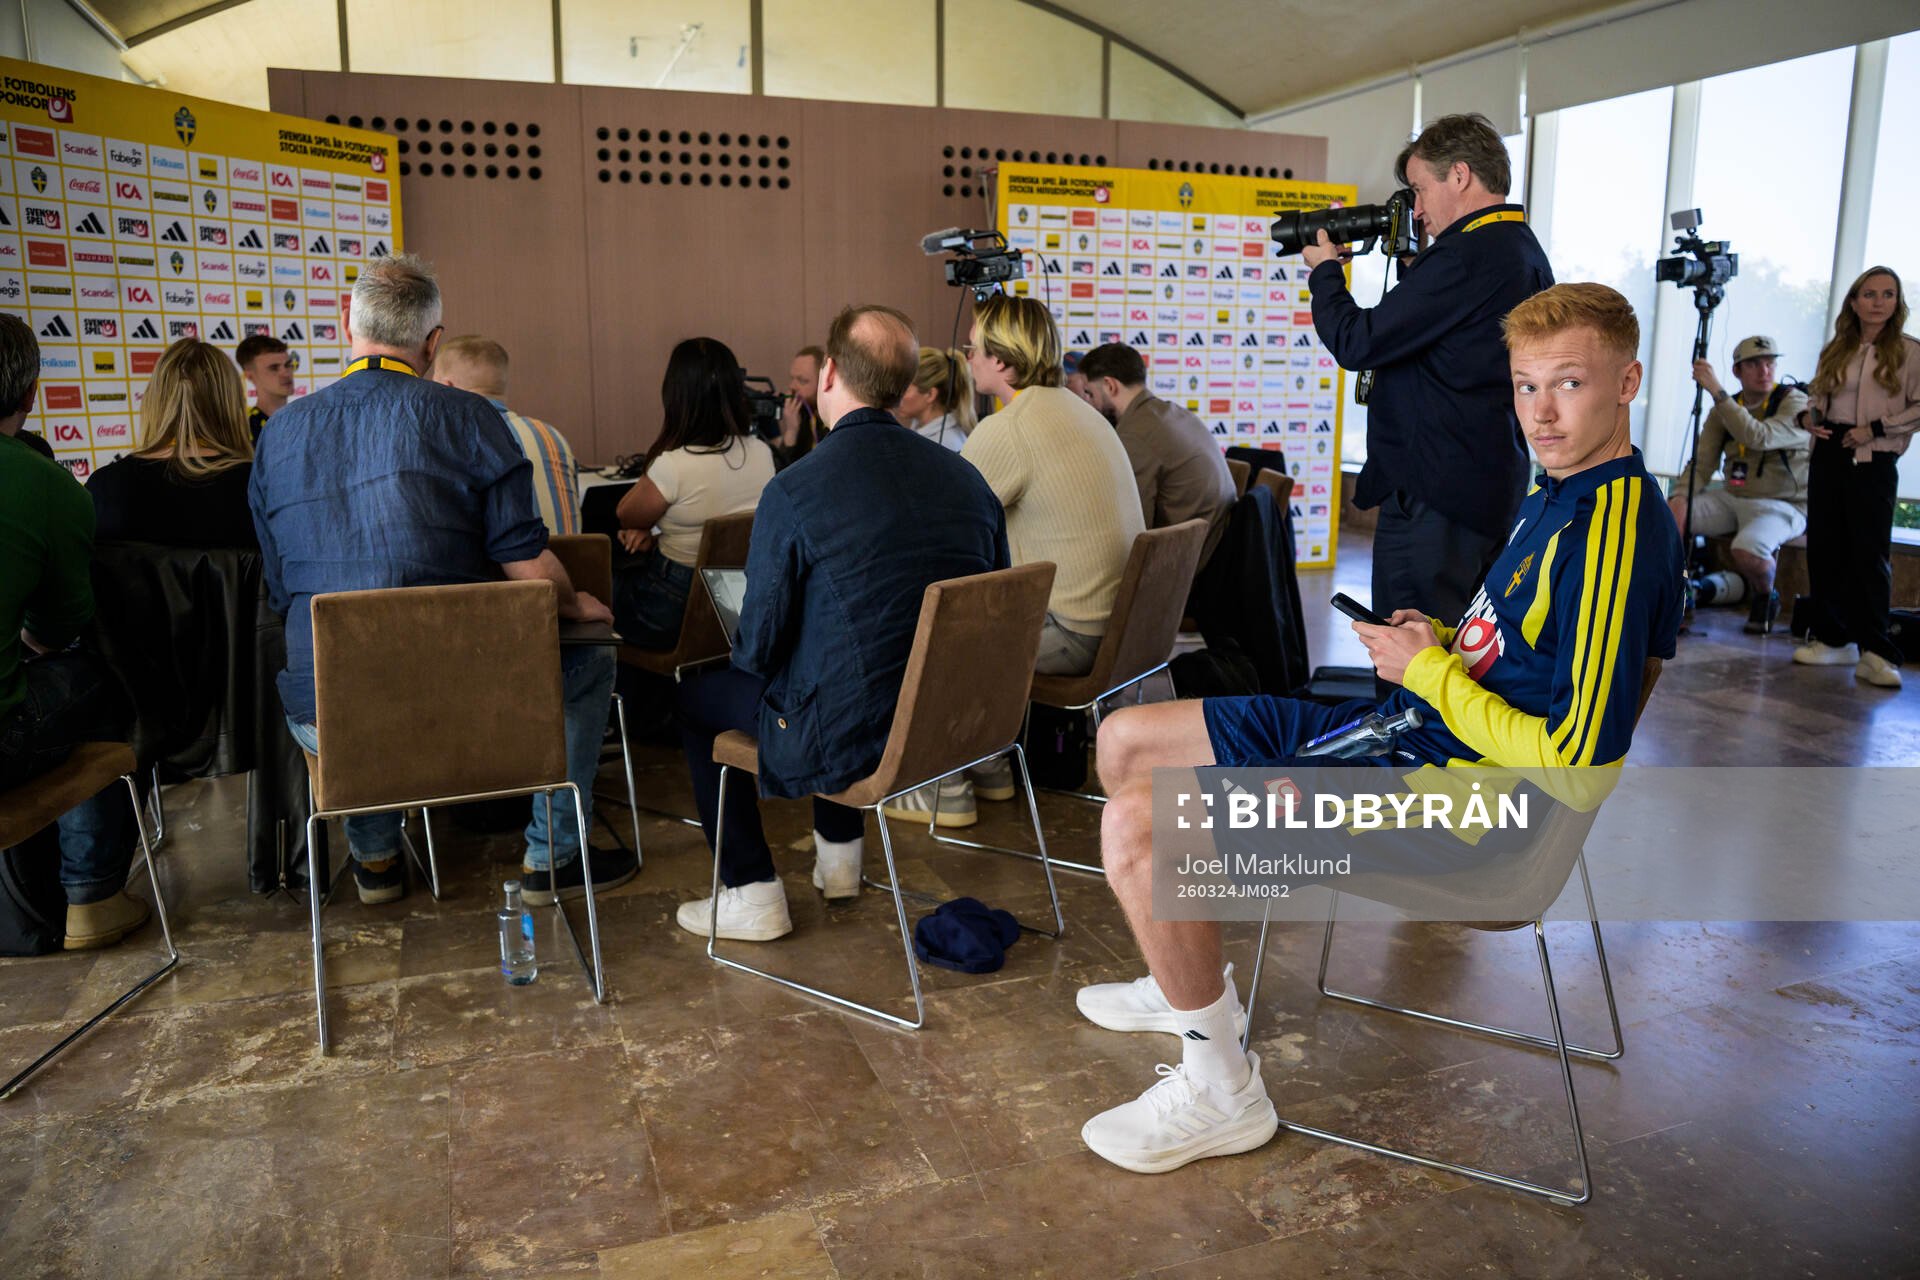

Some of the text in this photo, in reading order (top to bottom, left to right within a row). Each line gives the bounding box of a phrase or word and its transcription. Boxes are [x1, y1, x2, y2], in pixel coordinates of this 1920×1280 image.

[4, 77, 76, 101] FOTBOLLENS
[279, 130, 312, 144] SVENSKA
[314, 135, 331, 147] SPEL
[64, 143, 98, 157] Scandic
[280, 142, 308, 155] STOLTA
[110, 150, 142, 167] Fabege
[271, 171, 293, 188] ICA
[116, 182, 142, 200] ICA
[25, 207, 59, 217] SVENSKA
[27, 216, 45, 226] SPEL
[118, 217, 148, 226] SVENSKA
[1246, 222, 1263, 233] ICA
[1132, 239, 1150, 250] ICA
[312, 266, 331, 280] ICA
[81, 288, 115, 298] Scandic
[127, 287, 154, 303] ICA
[1131, 310, 1149, 320] ICA
[84, 318, 116, 327] SVENSKA
[85, 326, 102, 335] SPEL
[42, 357, 76, 368] Folksam
[1185, 357, 1202, 367] ICA
[54, 425, 83, 441] ICA
